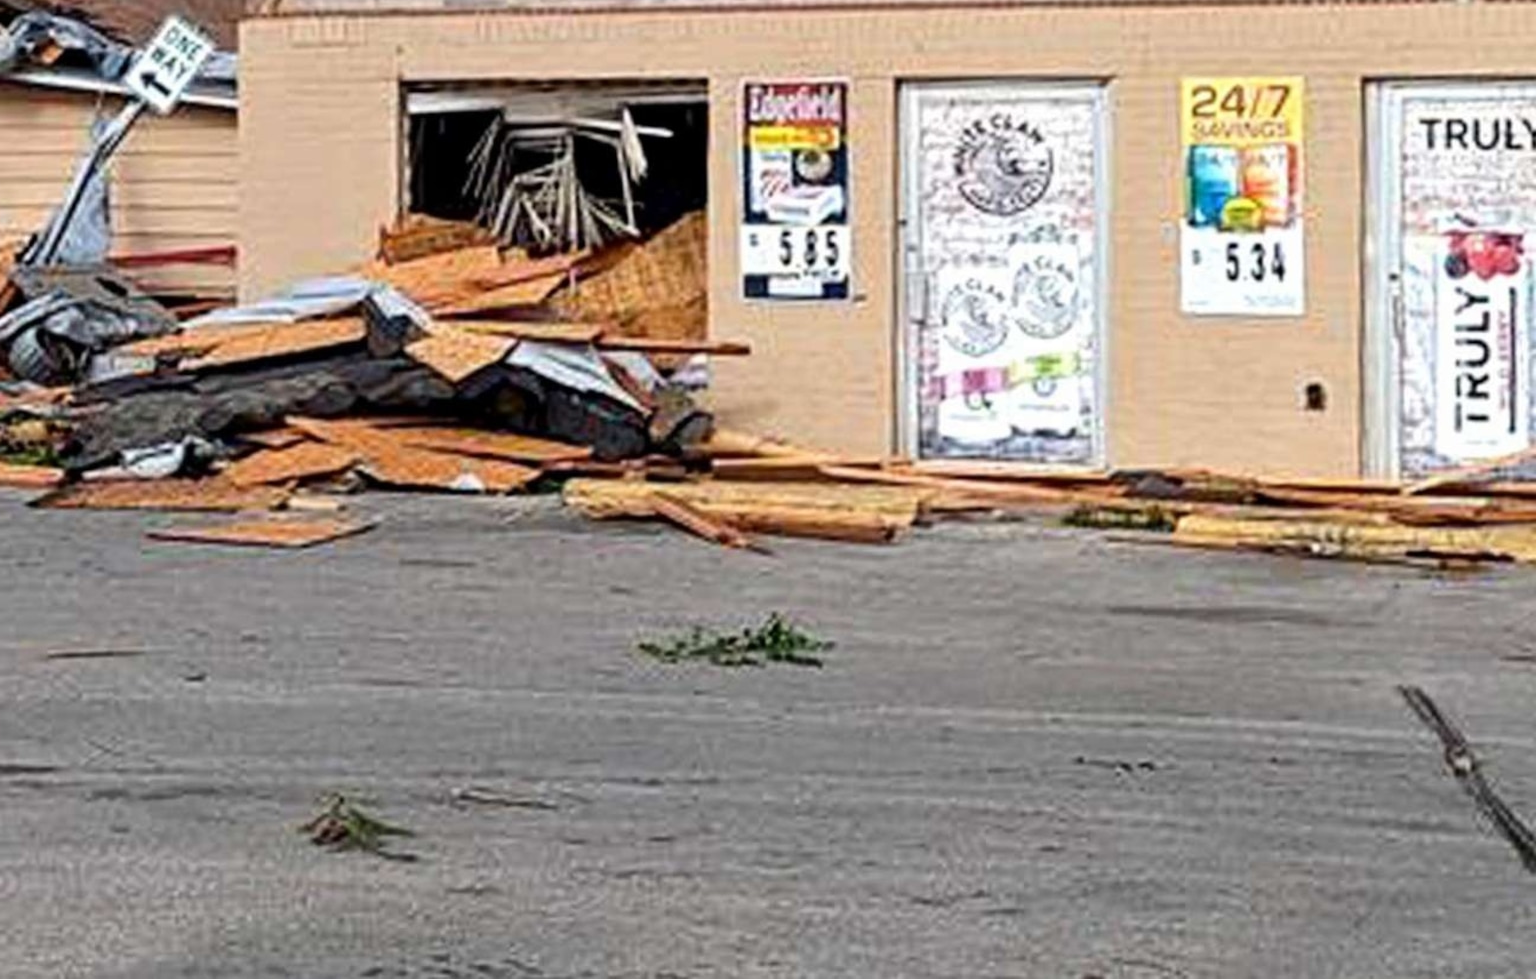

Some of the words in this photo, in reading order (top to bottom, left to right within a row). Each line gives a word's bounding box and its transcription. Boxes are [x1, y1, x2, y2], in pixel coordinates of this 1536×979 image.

[164, 25, 203, 62] ONE
[151, 48, 188, 81] WAY
[749, 85, 842, 123] Edgefield
[1190, 84, 1292, 118] 24/7
[953, 120, 988, 176] WHITE
[989, 113, 1044, 145] CLAW
[1192, 123, 1292, 139] SAVINGS
[1418, 118, 1536, 151] TRULY
[779, 229, 839, 267] 5.85
[1226, 241, 1286, 283] 5.34
[1455, 286, 1491, 433] TRULY
